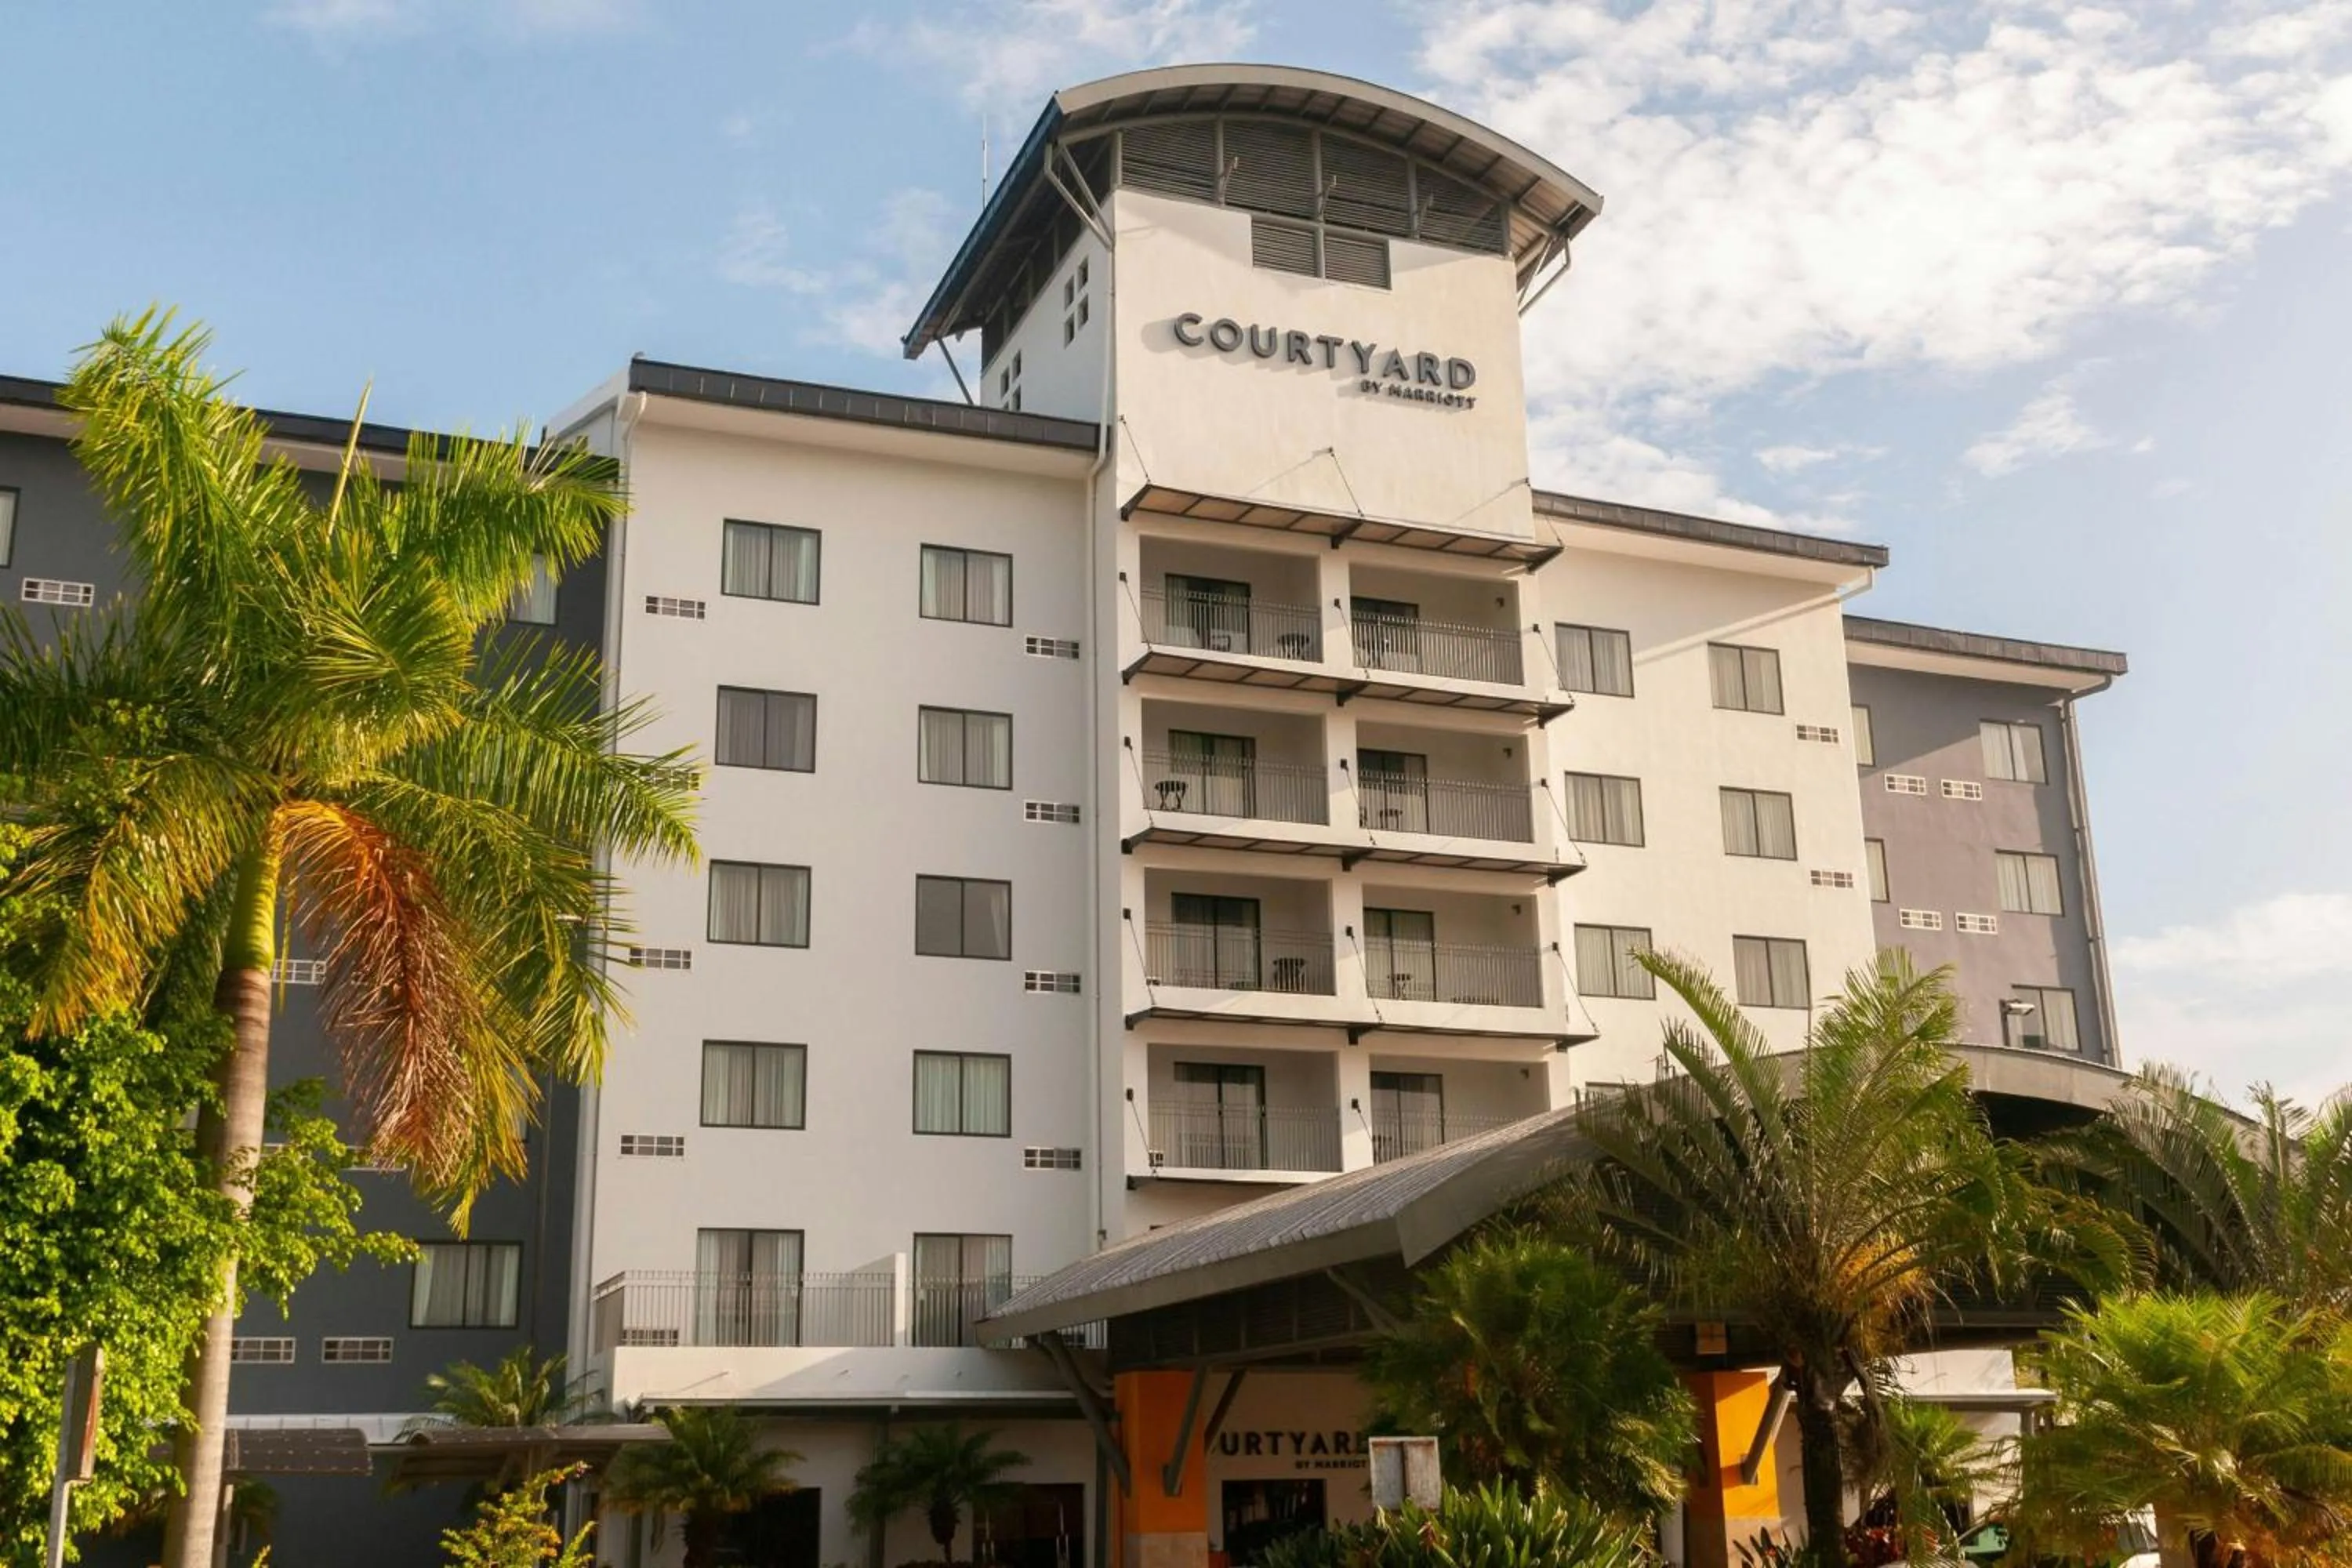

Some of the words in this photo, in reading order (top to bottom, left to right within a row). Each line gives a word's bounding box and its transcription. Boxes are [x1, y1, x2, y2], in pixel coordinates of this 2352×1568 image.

[1174, 312, 1477, 390] COURTYARD
[1360, 379, 1383, 394] BY
[1388, 383, 1477, 409] MARRIOTT
[1219, 1430, 1368, 1456] URTYAR
[1295, 1459, 1310, 1470] BY
[1315, 1458, 1367, 1469] MARRIOT
